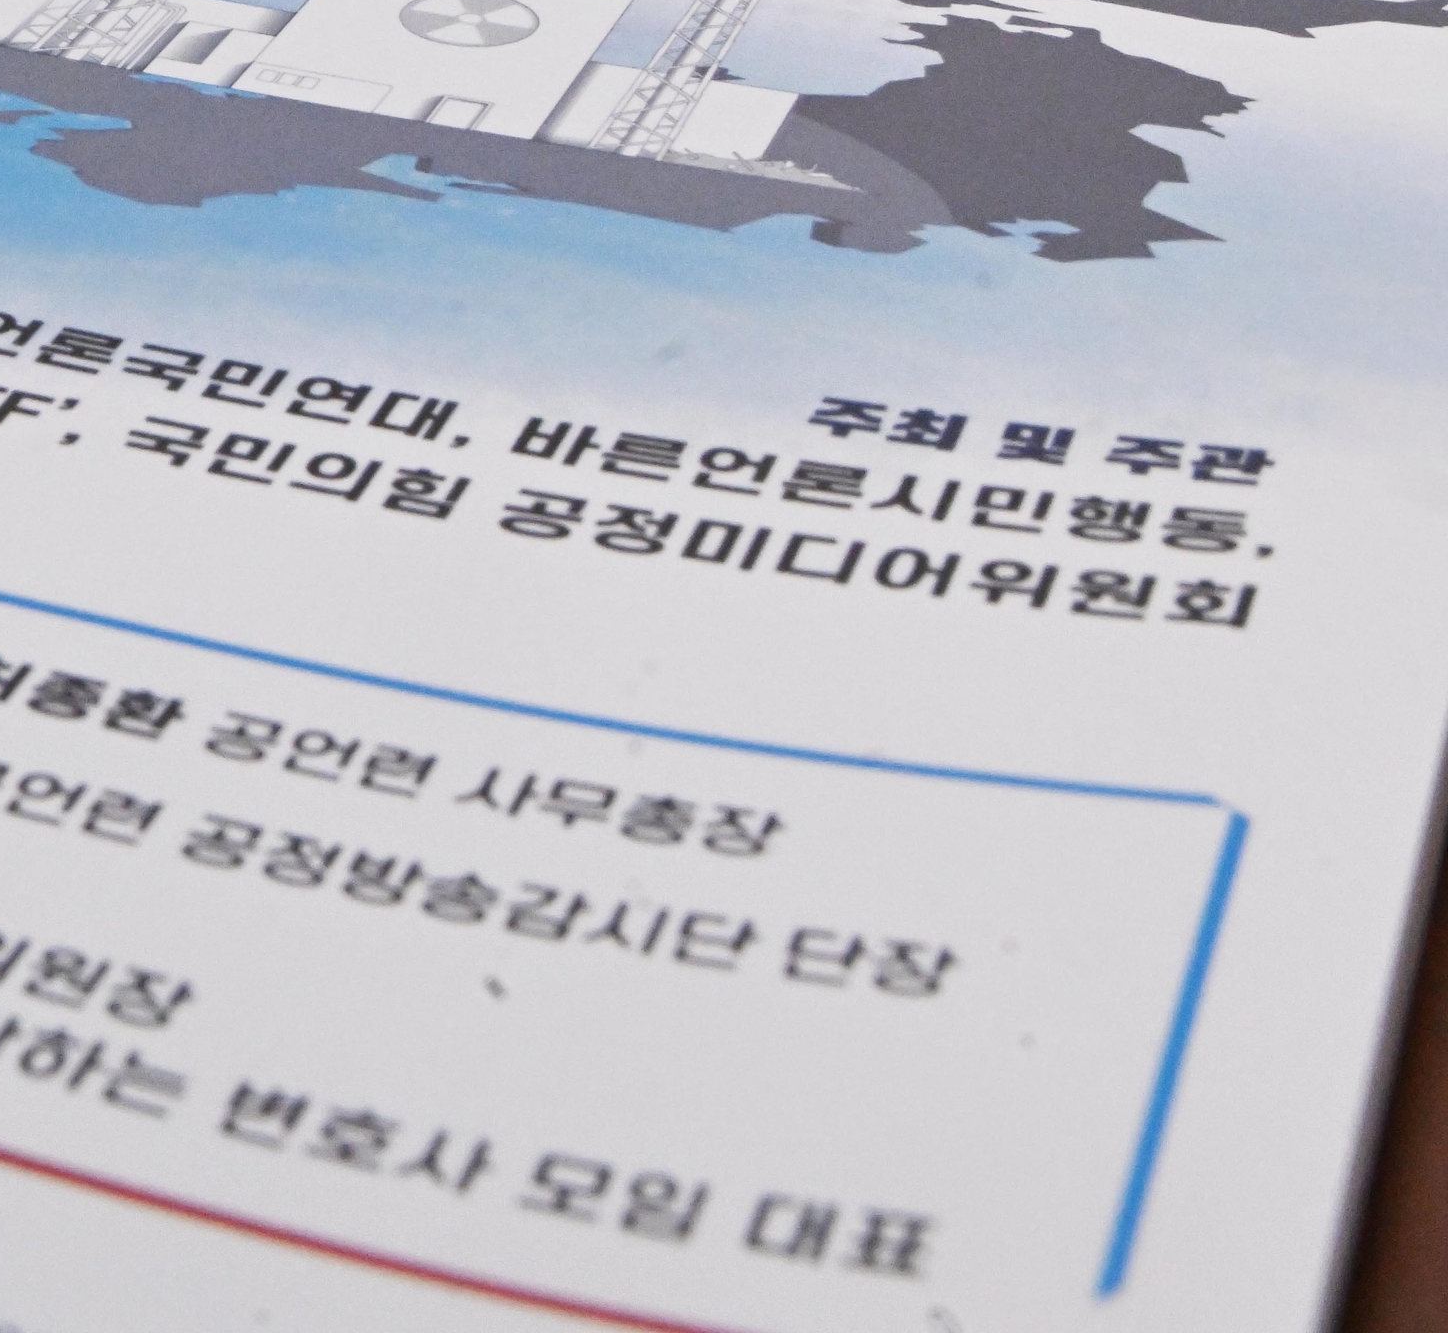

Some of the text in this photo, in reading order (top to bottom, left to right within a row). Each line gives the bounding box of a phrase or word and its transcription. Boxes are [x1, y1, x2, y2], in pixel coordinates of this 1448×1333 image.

[126, 416, 472, 521] 국민의힘
[498, 487, 1259, 629] 공정미디어위원회
[512, 416, 1275, 559] 바른언론시민행동,
[807, 396, 1276, 488] 주최 및 주관
[204, 709, 438, 799] 공언련
[454, 765, 790, 858] 사무총장
[179, 812, 758, 972] 공정방송감시단
[784, 927, 964, 999] 단장
[217, 1079, 497, 1197] 변호사
[518, 1150, 715, 1245] 모임
[741, 1190, 934, 1278] 대표
